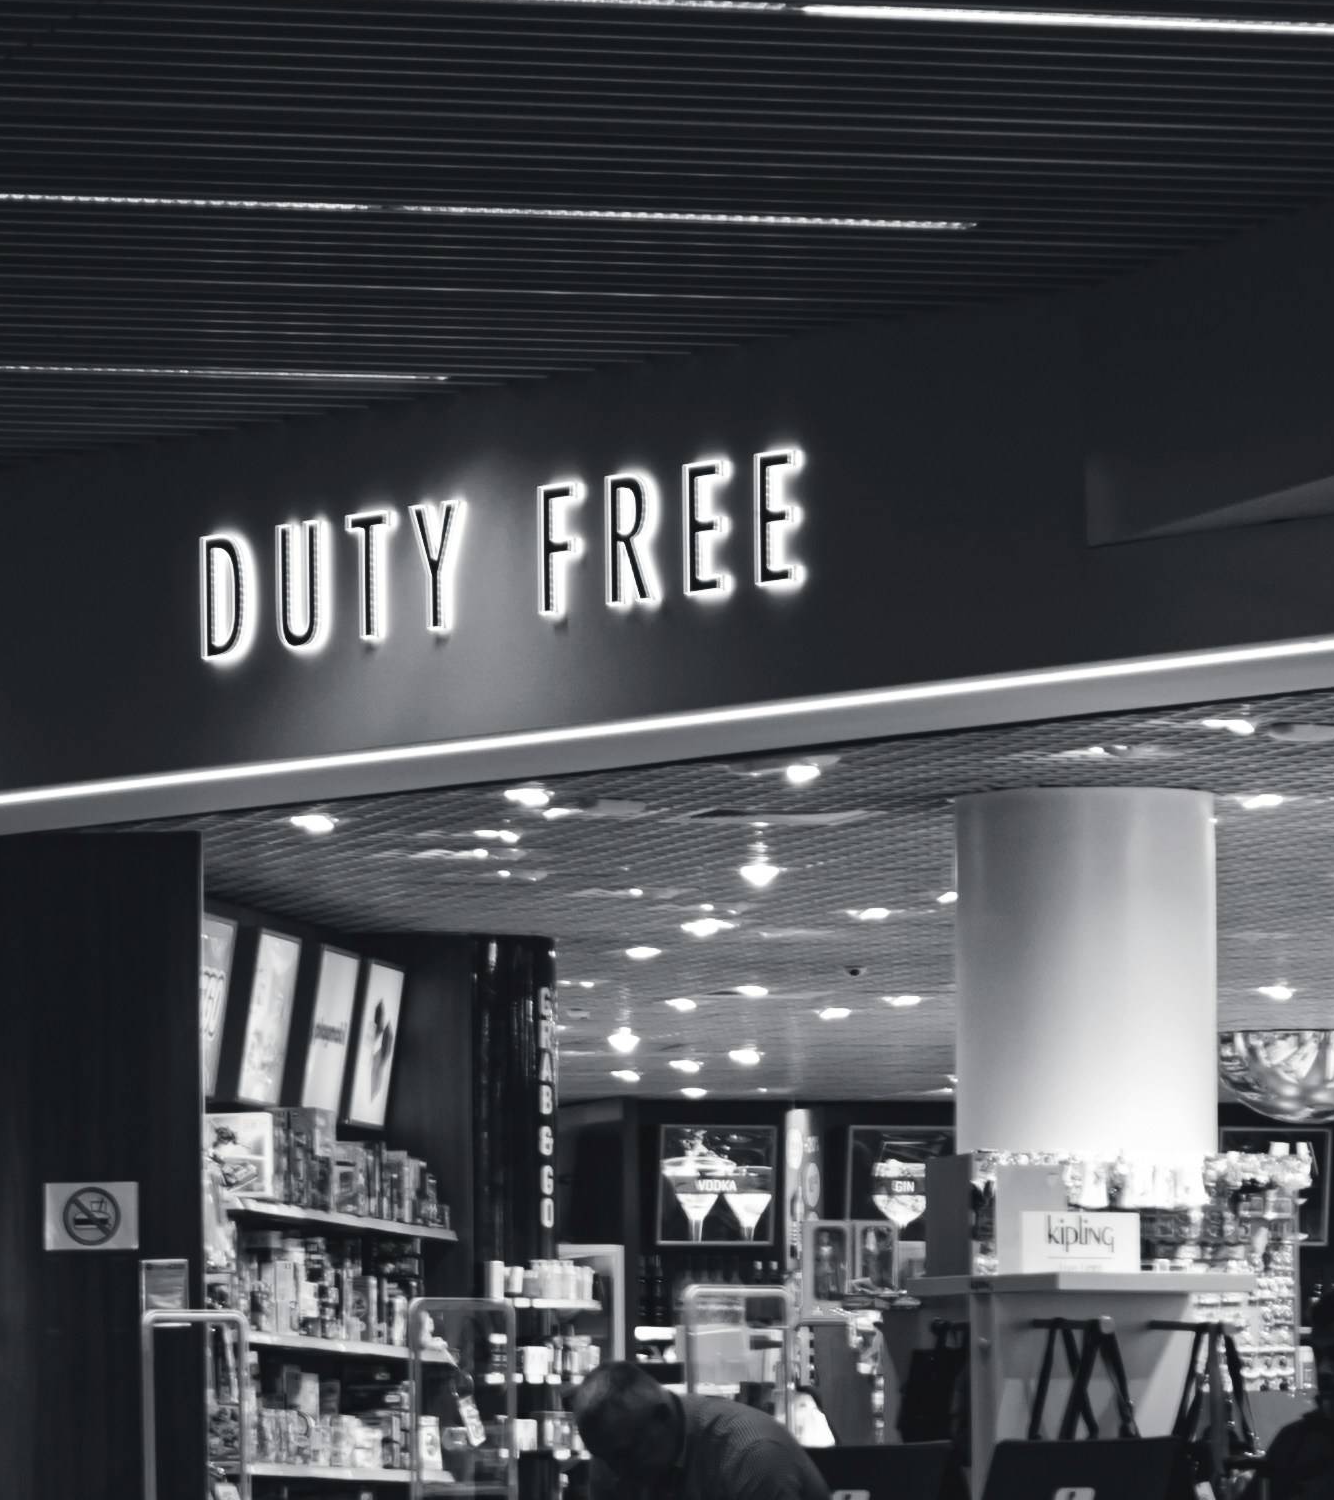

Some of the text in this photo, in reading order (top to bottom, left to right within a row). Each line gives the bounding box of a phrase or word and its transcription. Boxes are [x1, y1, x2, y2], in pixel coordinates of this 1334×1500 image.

[199, 446, 806, 664] DUTY FREE
[697, 1179, 737, 1192] VODKA
[892, 1180, 915, 1193] GIN
[1046, 1214, 1114, 1253] kipling
